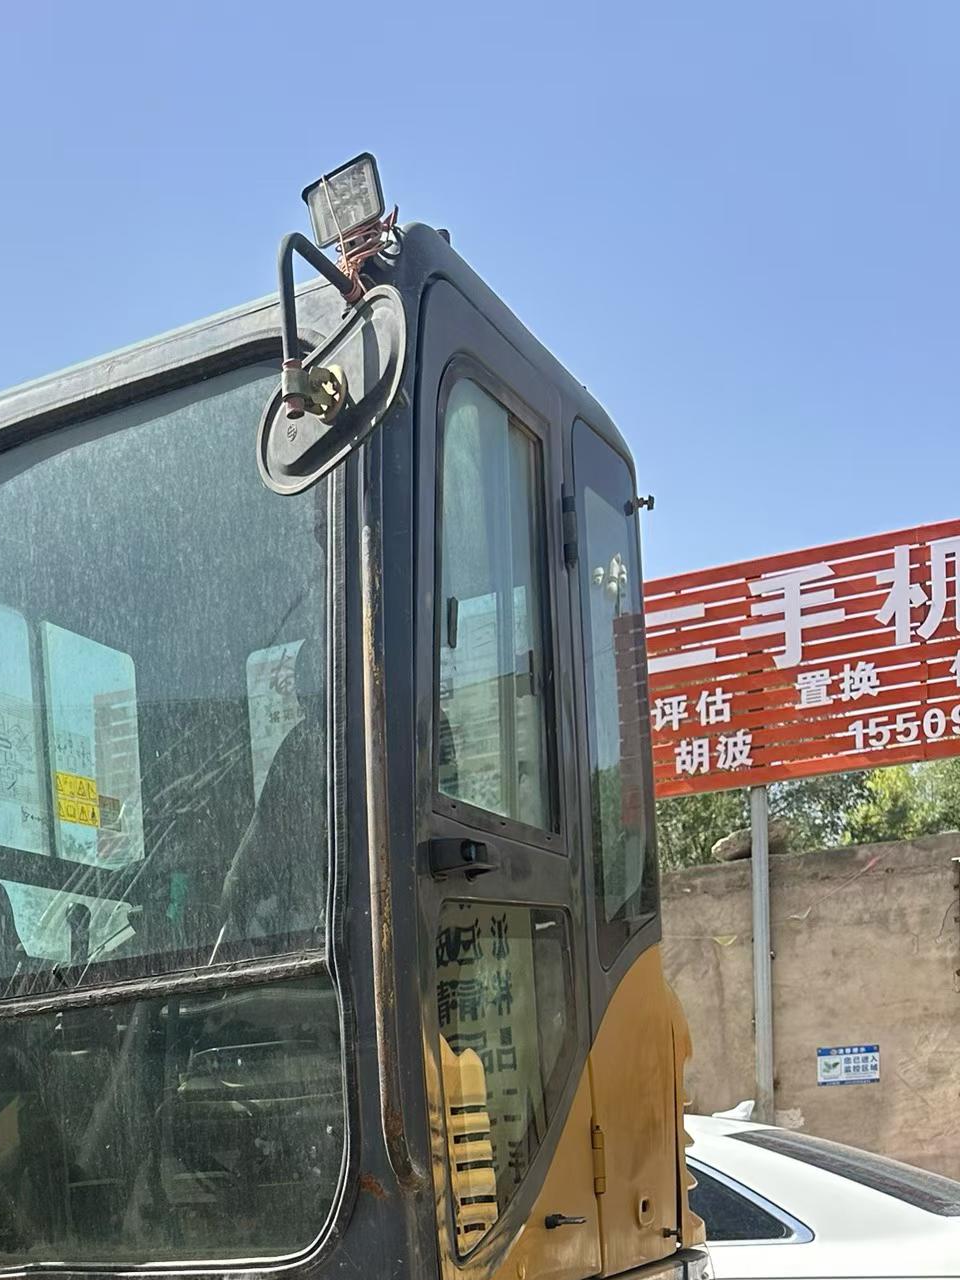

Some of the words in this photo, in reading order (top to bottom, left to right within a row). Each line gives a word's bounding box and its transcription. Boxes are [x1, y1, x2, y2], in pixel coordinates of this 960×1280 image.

[650, 687, 733, 733] 评估
[794, 660, 881, 710] 置换
[674, 728, 754, 776] 胡波
